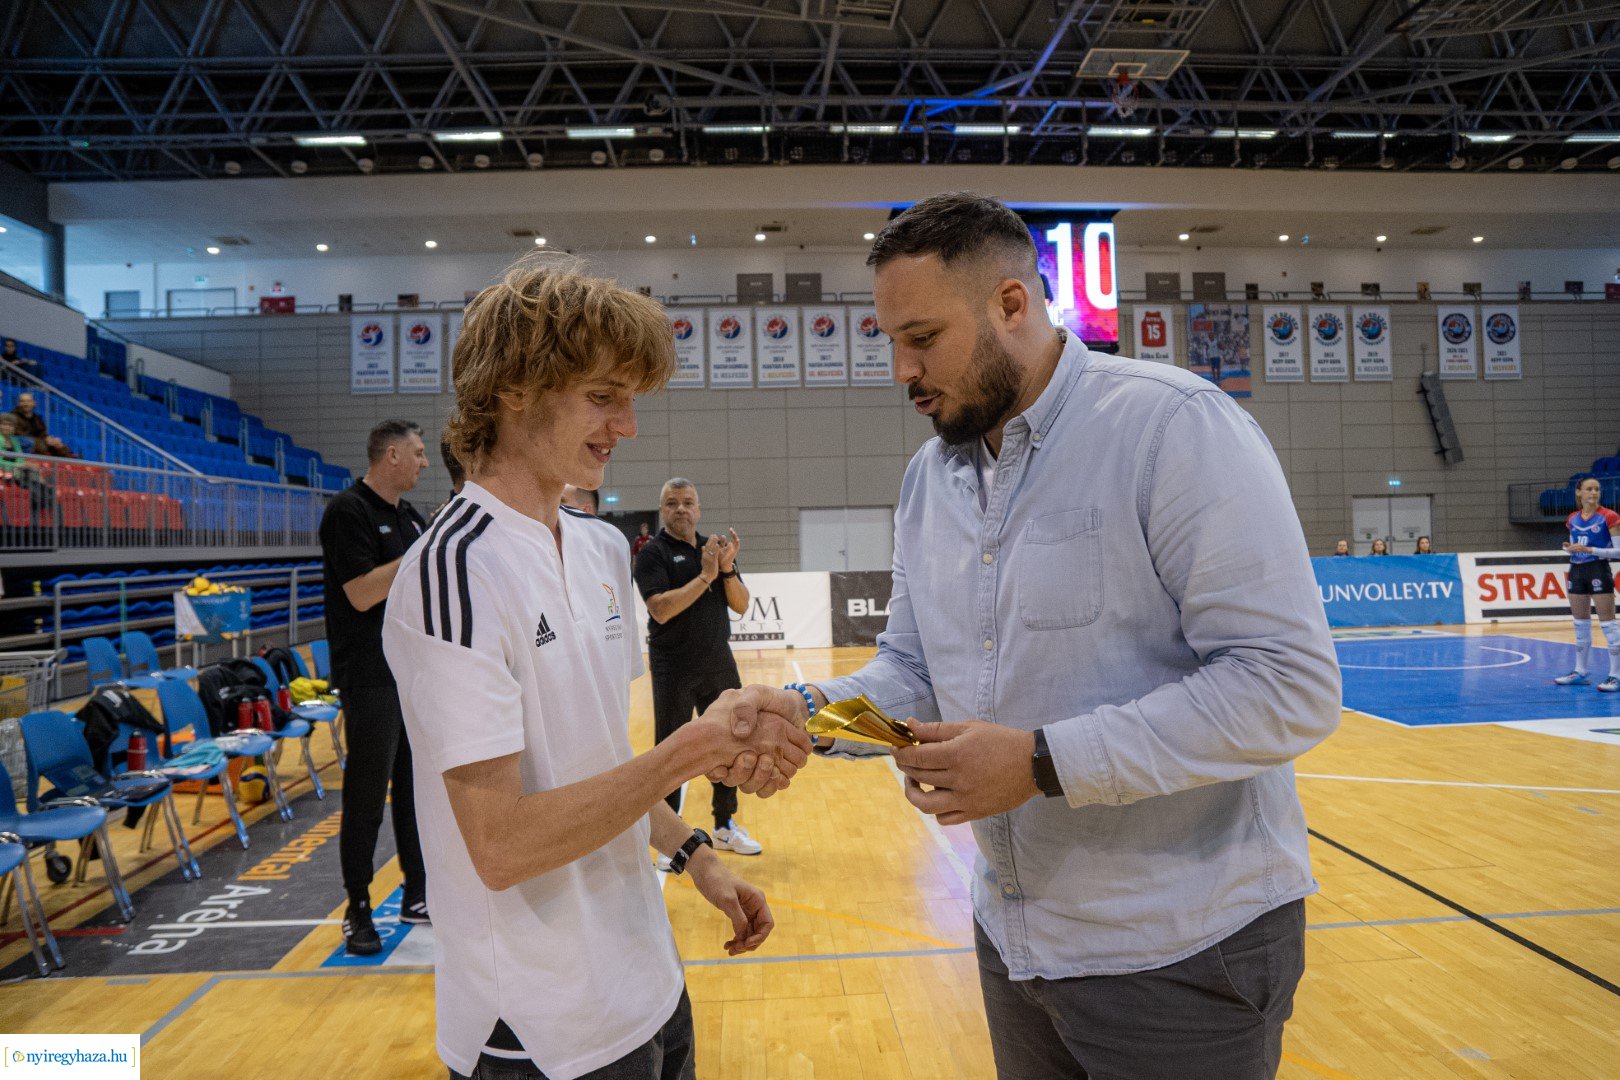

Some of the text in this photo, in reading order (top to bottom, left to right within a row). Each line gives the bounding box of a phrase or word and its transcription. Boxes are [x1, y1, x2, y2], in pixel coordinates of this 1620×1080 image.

[1046, 222, 1118, 310] 10
[1147, 324, 1161, 340] 15
[1319, 581, 1453, 603] UNVOLLEY.TV
[847, 598, 891, 617] BL
[739, 621, 783, 631] RTY
[535, 631, 556, 648] adidas
